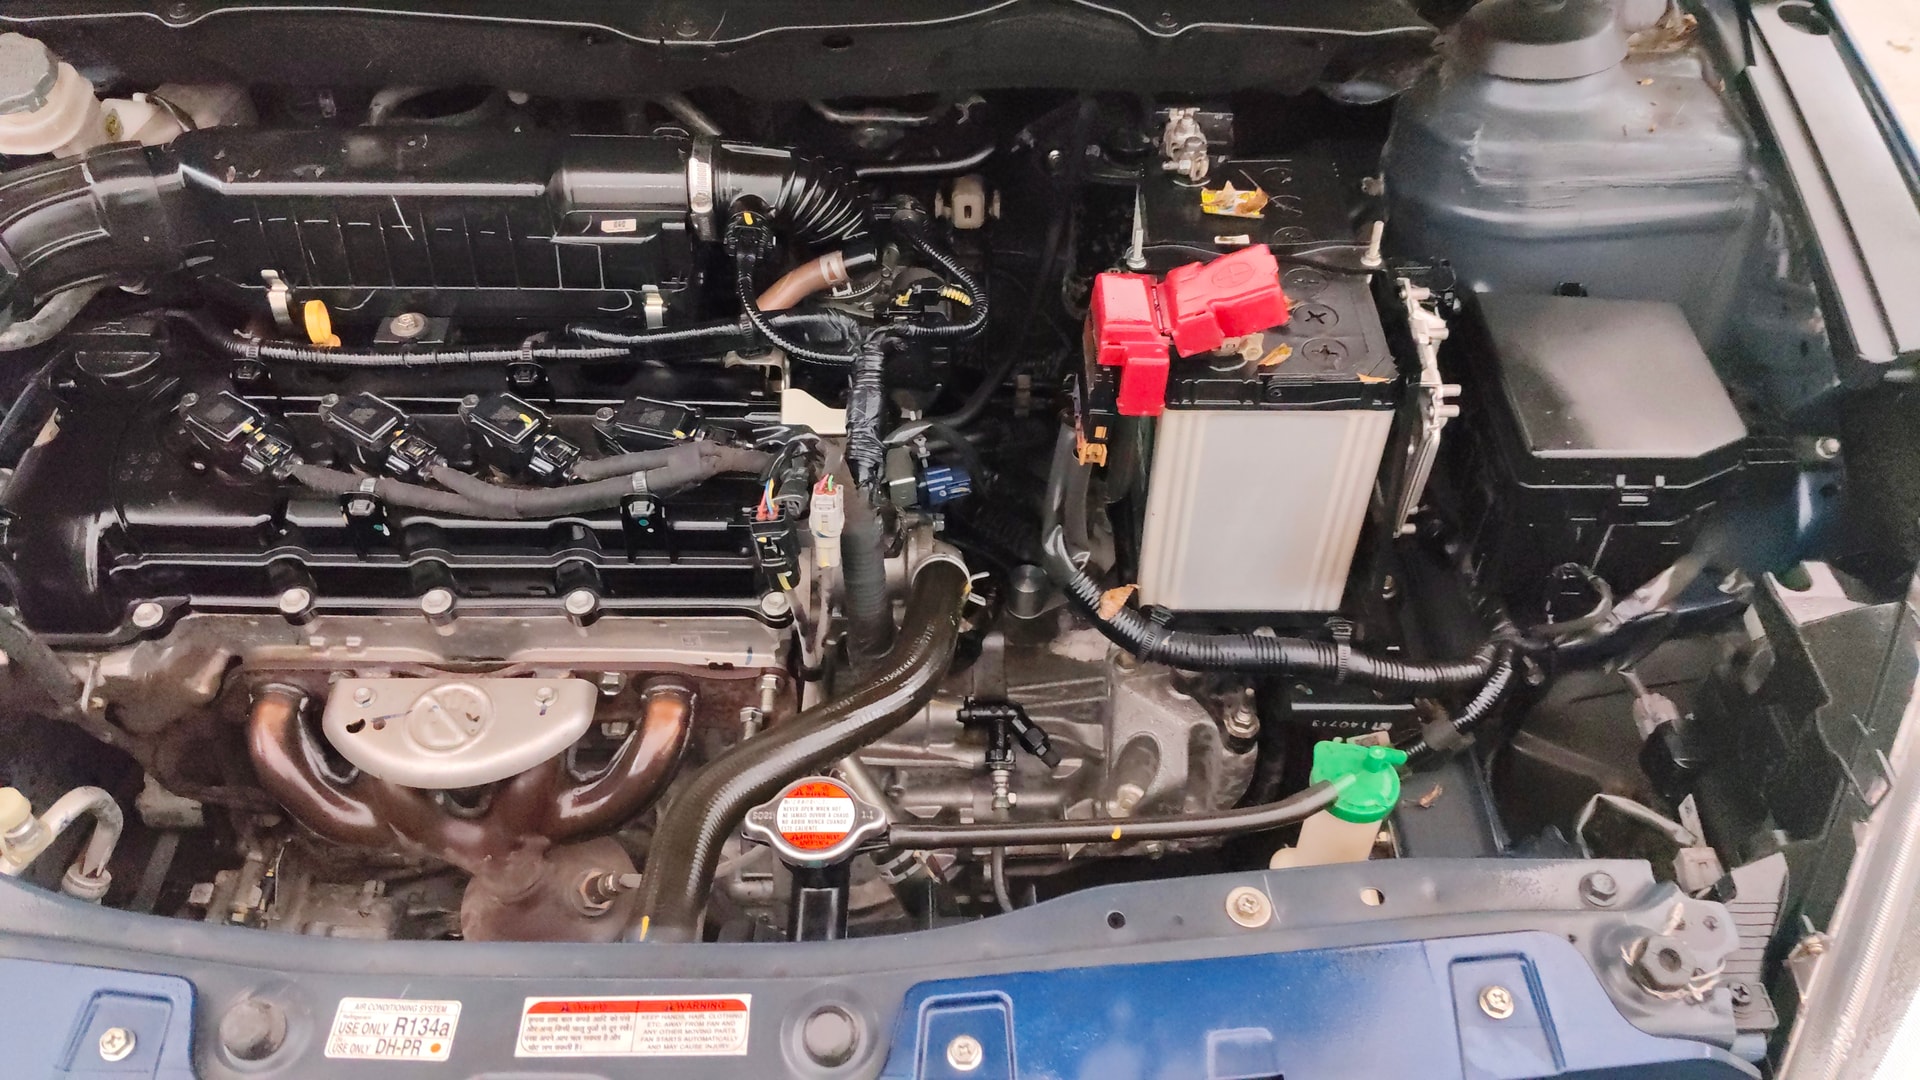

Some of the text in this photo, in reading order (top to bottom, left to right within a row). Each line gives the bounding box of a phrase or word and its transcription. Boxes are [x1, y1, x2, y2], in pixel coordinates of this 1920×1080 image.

[354, 1003, 448, 1013] AIR CONDITIONING SYSTEM
[676, 1001, 727, 1010] WARNING
[338, 1016, 451, 1037] USE ONLY R134a
[332, 1038, 422, 1056] USE ONLY DH-PR
